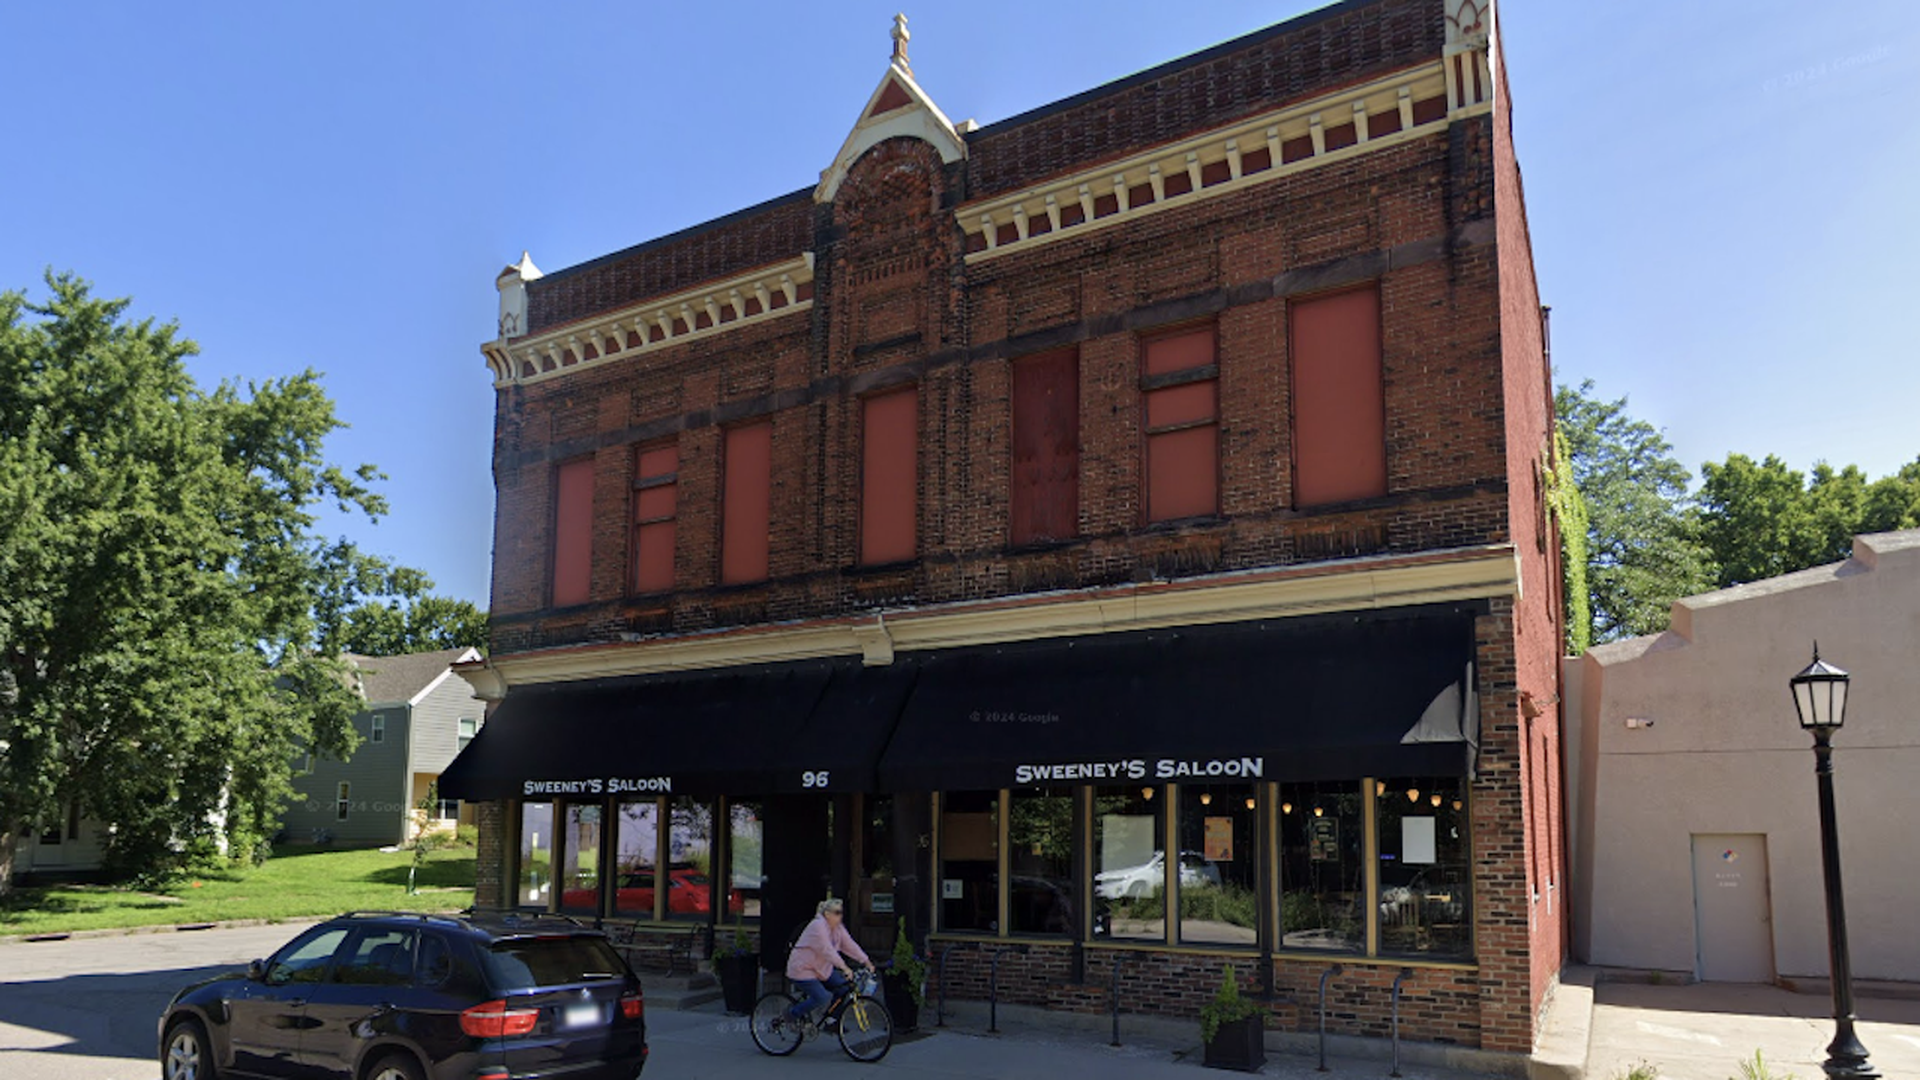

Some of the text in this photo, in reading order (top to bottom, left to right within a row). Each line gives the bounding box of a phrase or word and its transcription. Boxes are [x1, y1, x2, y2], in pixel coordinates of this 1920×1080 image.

[801, 770, 830, 788] 96
[1016, 757, 1263, 783] SWEENEY'S SALOON
[523, 776, 672, 795] SWEENEY'S SALOON
